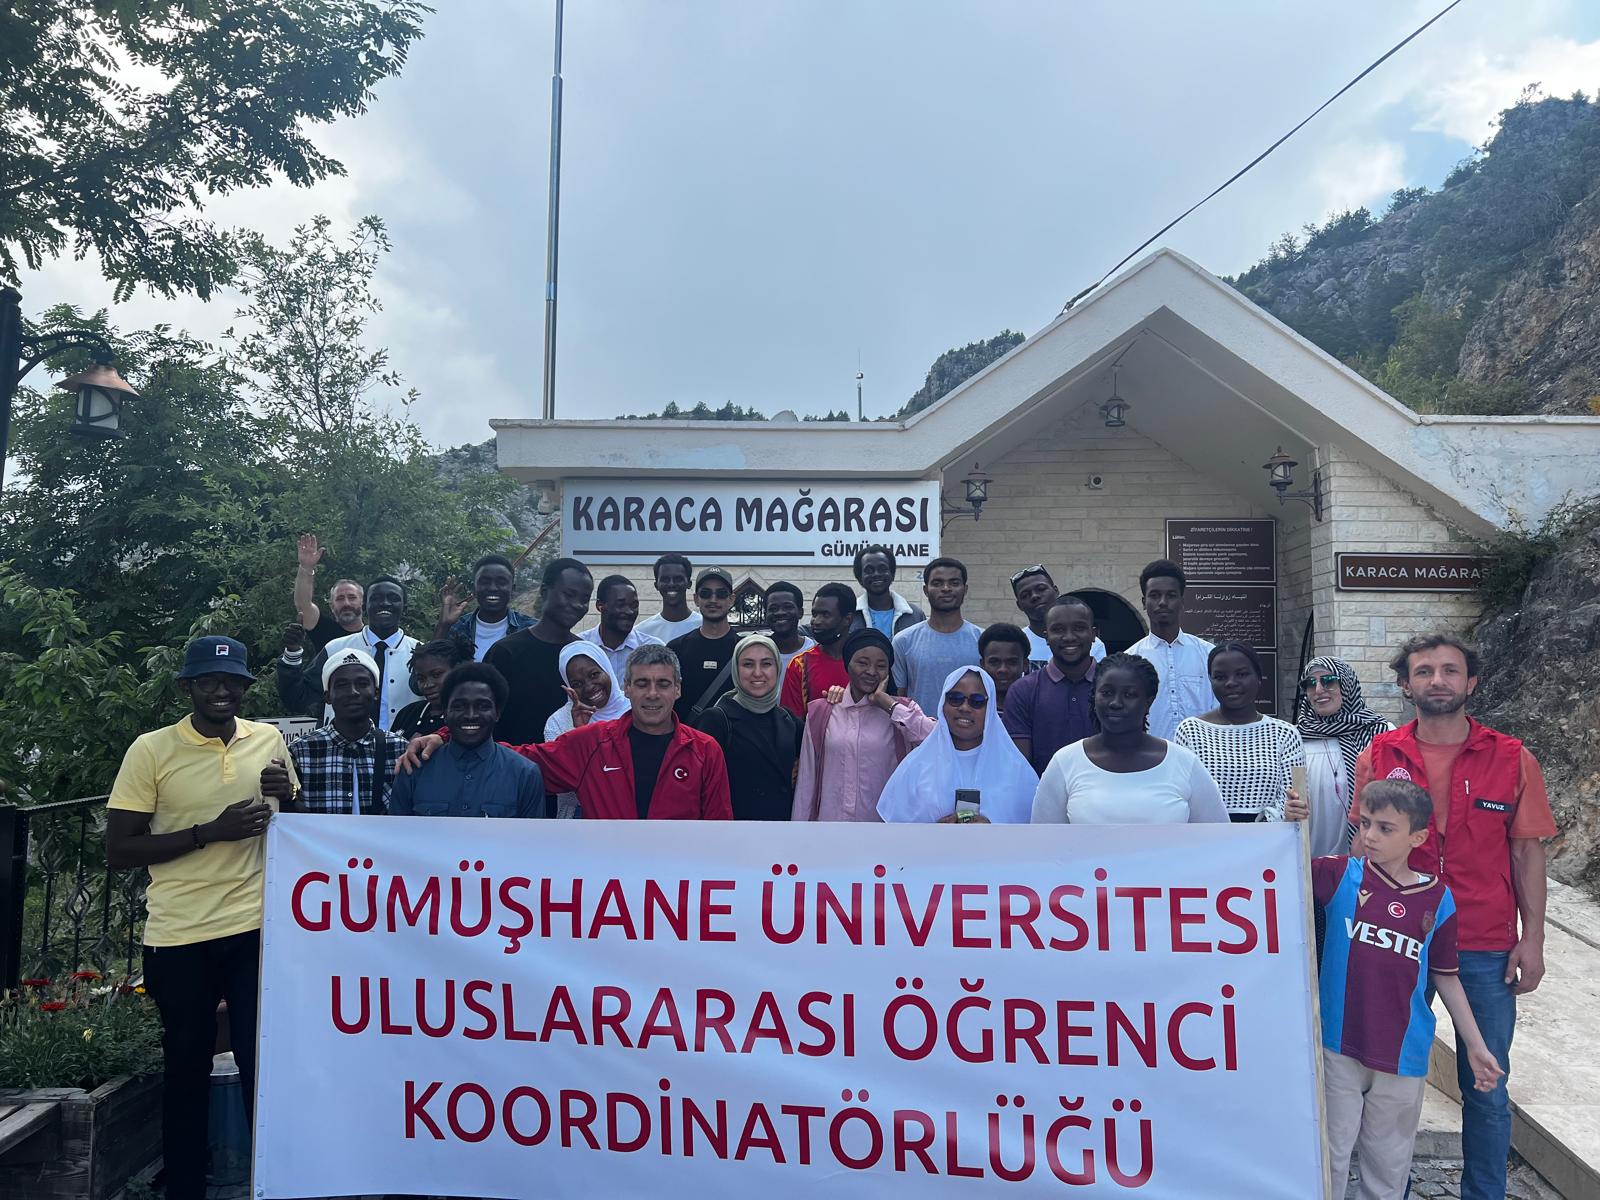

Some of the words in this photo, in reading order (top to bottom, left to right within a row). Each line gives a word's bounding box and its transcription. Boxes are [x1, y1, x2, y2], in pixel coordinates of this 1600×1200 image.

[572, 496, 723, 532] KARACA
[735, 488, 930, 533] MAĞARASI
[820, 540, 930, 557] GÜMÜHANE
[1346, 566, 1409, 578] KARACA
[1414, 565, 1494, 579] MAĞARAS
[1482, 801, 1505, 811] YAVUZ
[291, 857, 737, 954] GÜMÜŞHANE
[761, 863, 1280, 955] ÜNİVERSİTESİ
[331, 975, 855, 1056] ULUSLARARASI
[883, 976, 1239, 1071] ÖĞRENCİ
[404, 1078, 1154, 1188] KOORDİNATÖRLÜĞÜ
